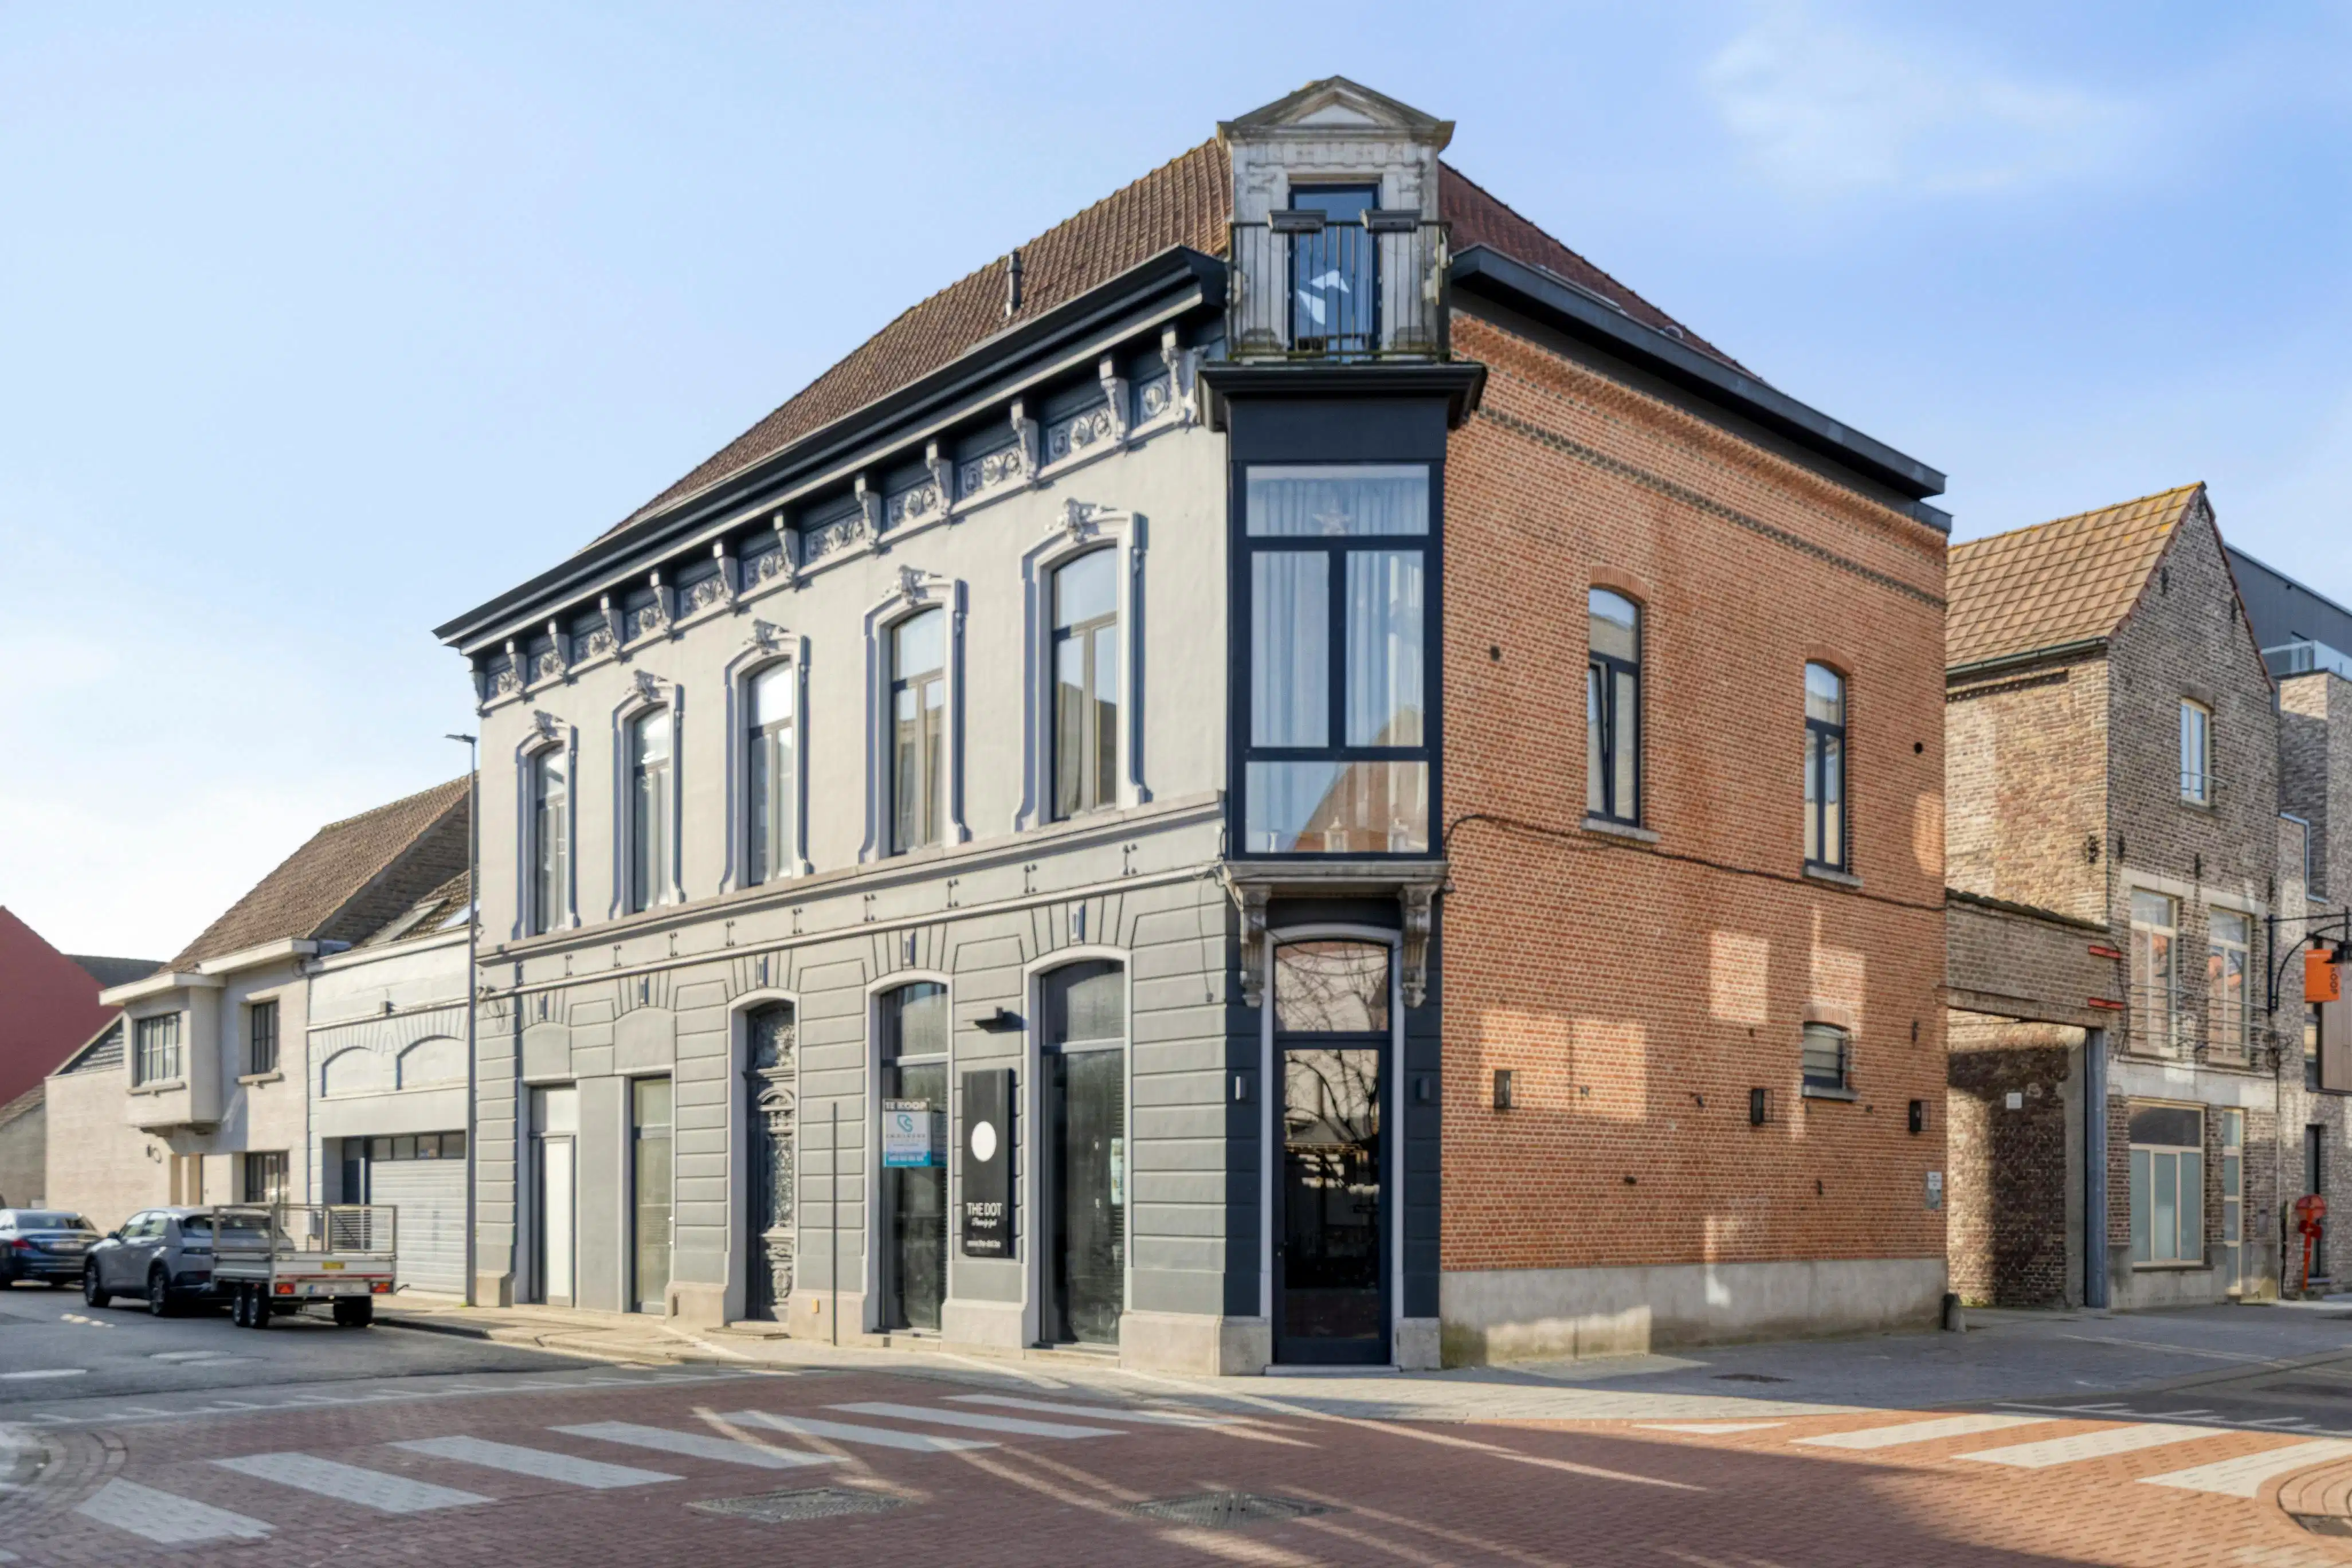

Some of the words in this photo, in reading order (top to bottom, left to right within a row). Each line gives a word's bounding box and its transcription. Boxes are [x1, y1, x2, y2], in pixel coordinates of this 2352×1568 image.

[885, 1101, 895, 1111] TE
[897, 1101, 927, 1111] KOOP
[966, 1202, 983, 1216] THE
[984, 1202, 1002, 1216] DOT
